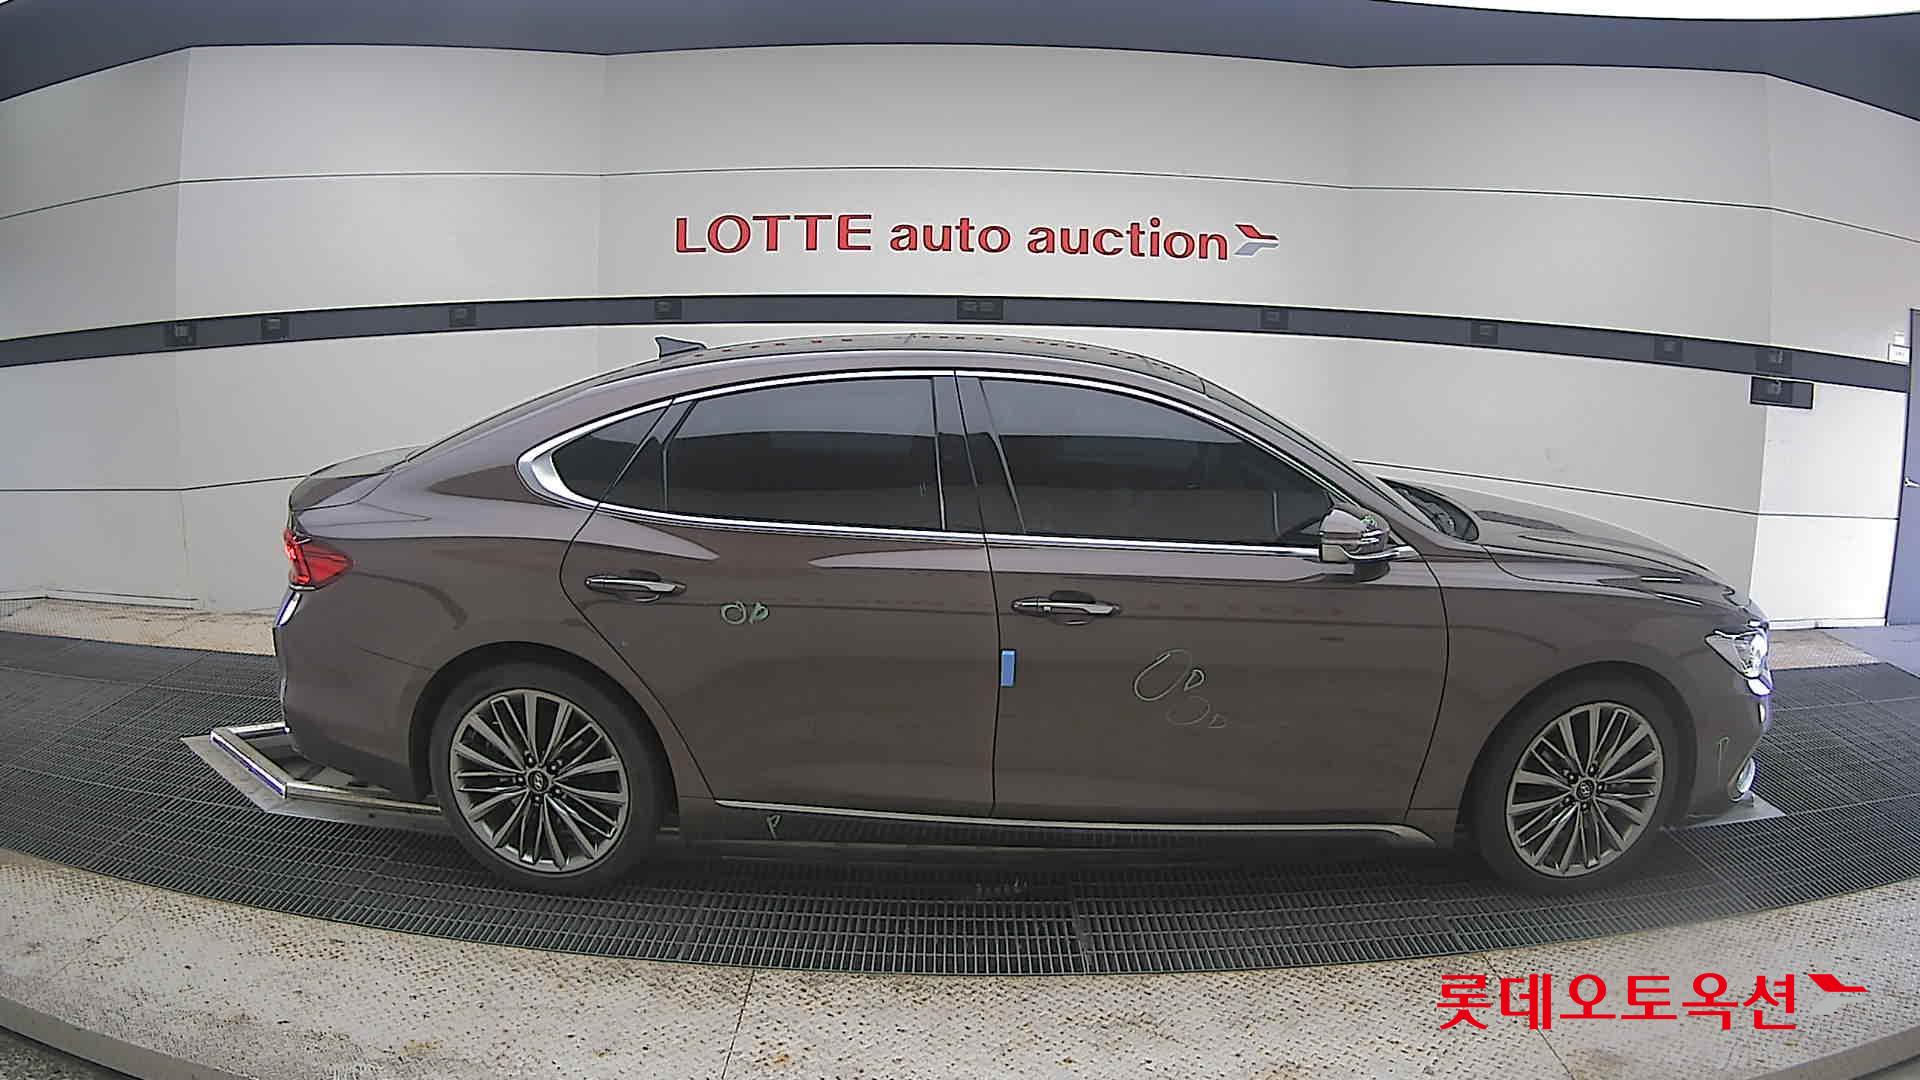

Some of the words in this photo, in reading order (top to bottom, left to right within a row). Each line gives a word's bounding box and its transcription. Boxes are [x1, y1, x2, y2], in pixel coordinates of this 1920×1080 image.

[674, 213, 873, 254] LOTTE
[888, 216, 1012, 254] auto
[1027, 216, 1229, 261] auction
